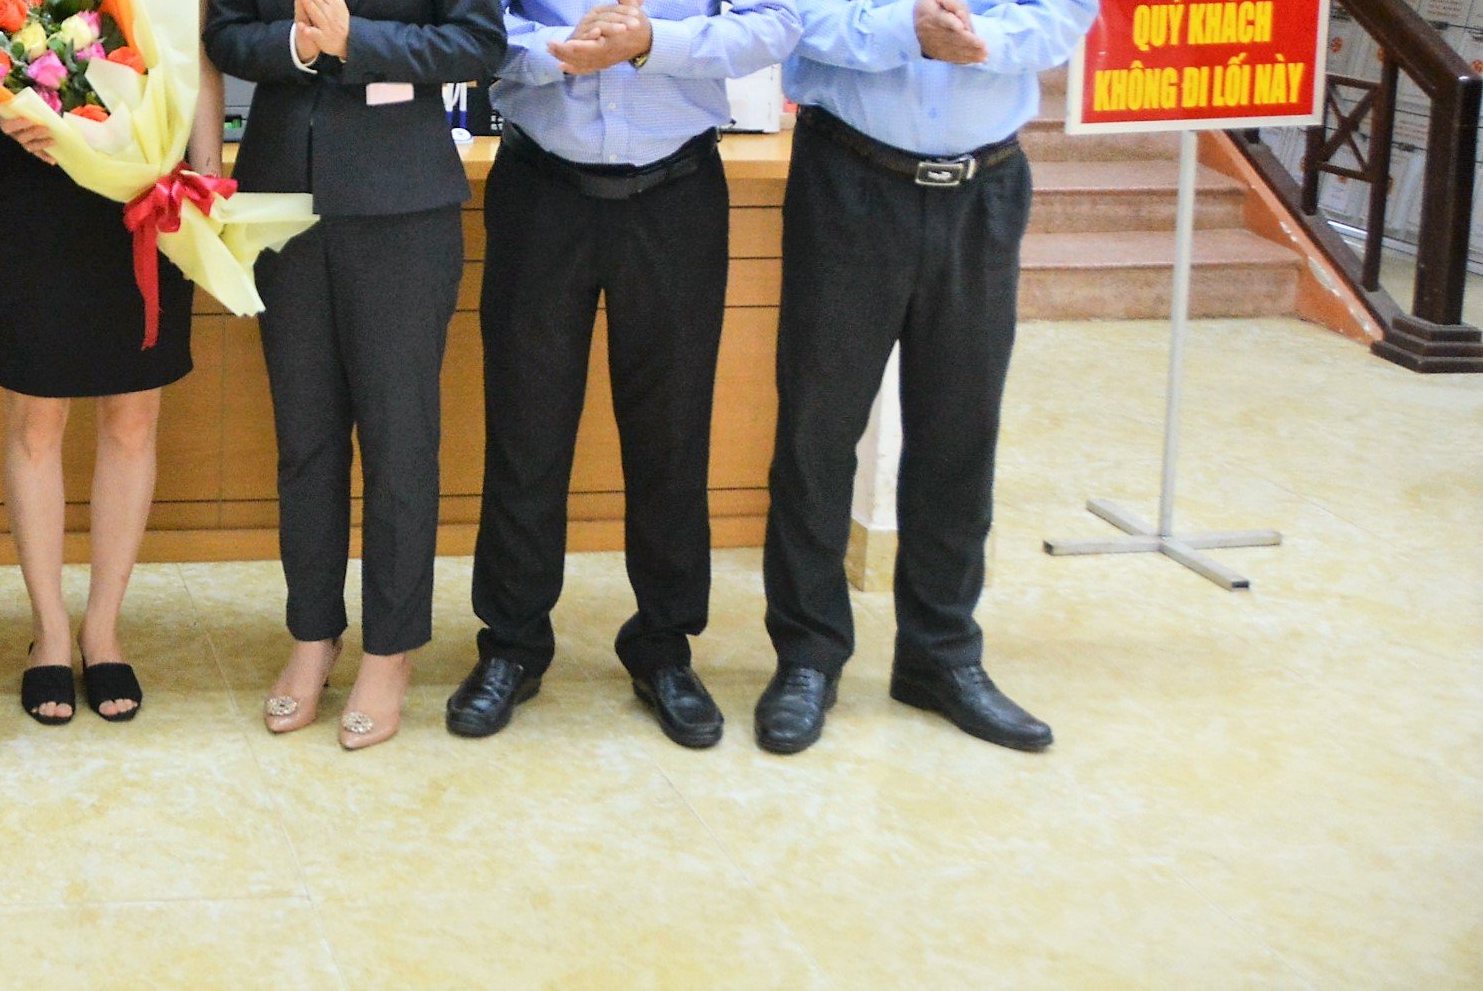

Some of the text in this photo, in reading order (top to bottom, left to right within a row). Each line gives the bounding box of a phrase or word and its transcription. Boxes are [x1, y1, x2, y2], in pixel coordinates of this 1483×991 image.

[1094, 52, 1304, 111] KHÔNG ĐI LỐI NÀY
